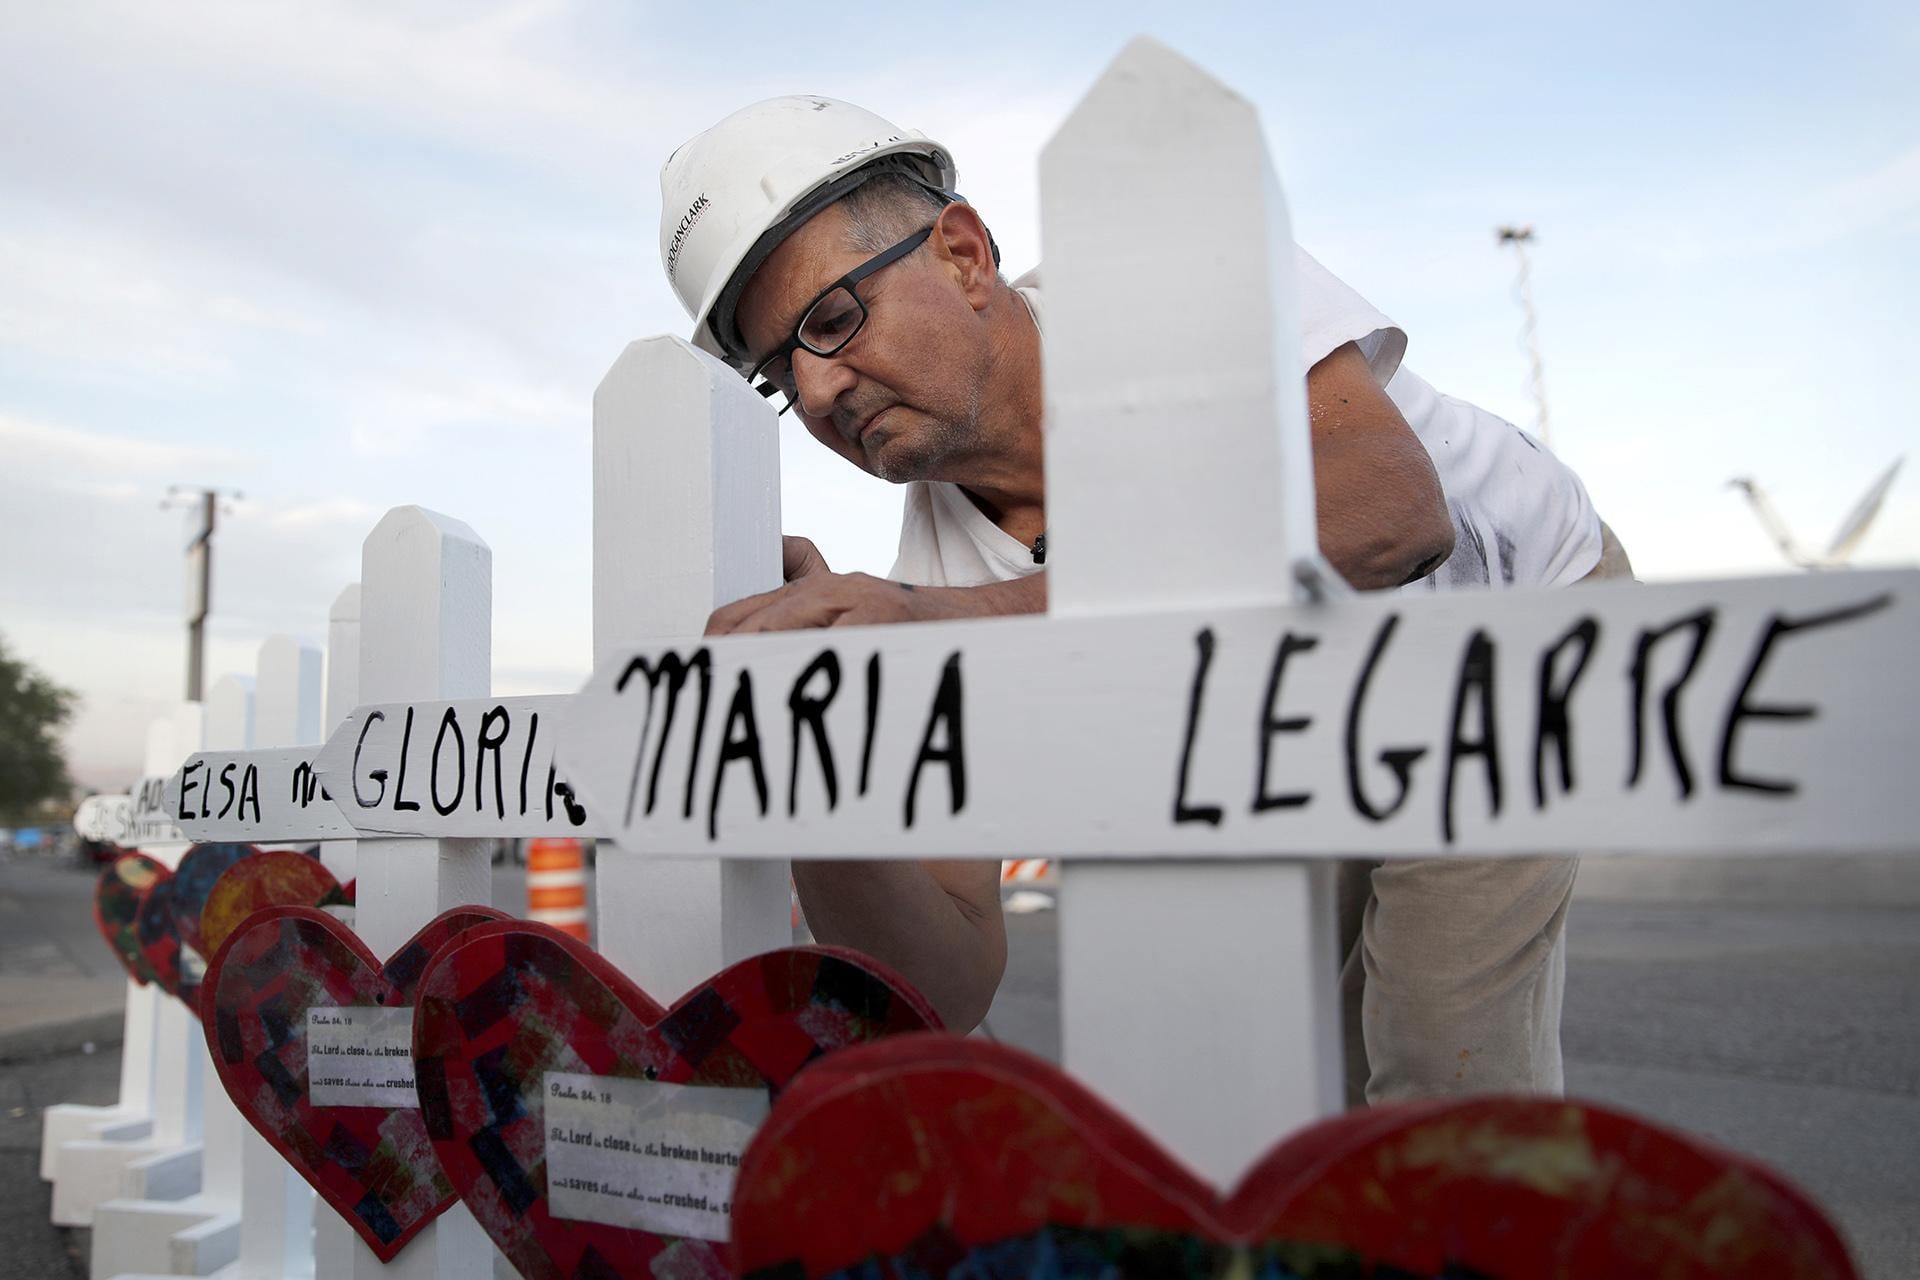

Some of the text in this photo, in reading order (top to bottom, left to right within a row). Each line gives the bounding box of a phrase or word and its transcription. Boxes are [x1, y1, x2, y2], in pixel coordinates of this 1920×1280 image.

[615, 594, 1893, 843] MARIA LEGARRE
[324, 1044, 339, 1055] Lord
[346, 1045, 365, 1055] close
[384, 1045, 409, 1056] broken
[324, 1078, 344, 1086] saves
[386, 1079, 414, 1089] crushed
[551, 1083, 578, 1100] Psalm
[600, 1092, 612, 1104] 18
[569, 1129, 592, 1146] Lord
[603, 1135, 631, 1152] close
[660, 1142, 699, 1161] broken
[569, 1177, 599, 1193] saves
[663, 1193, 708, 1211] crushed
